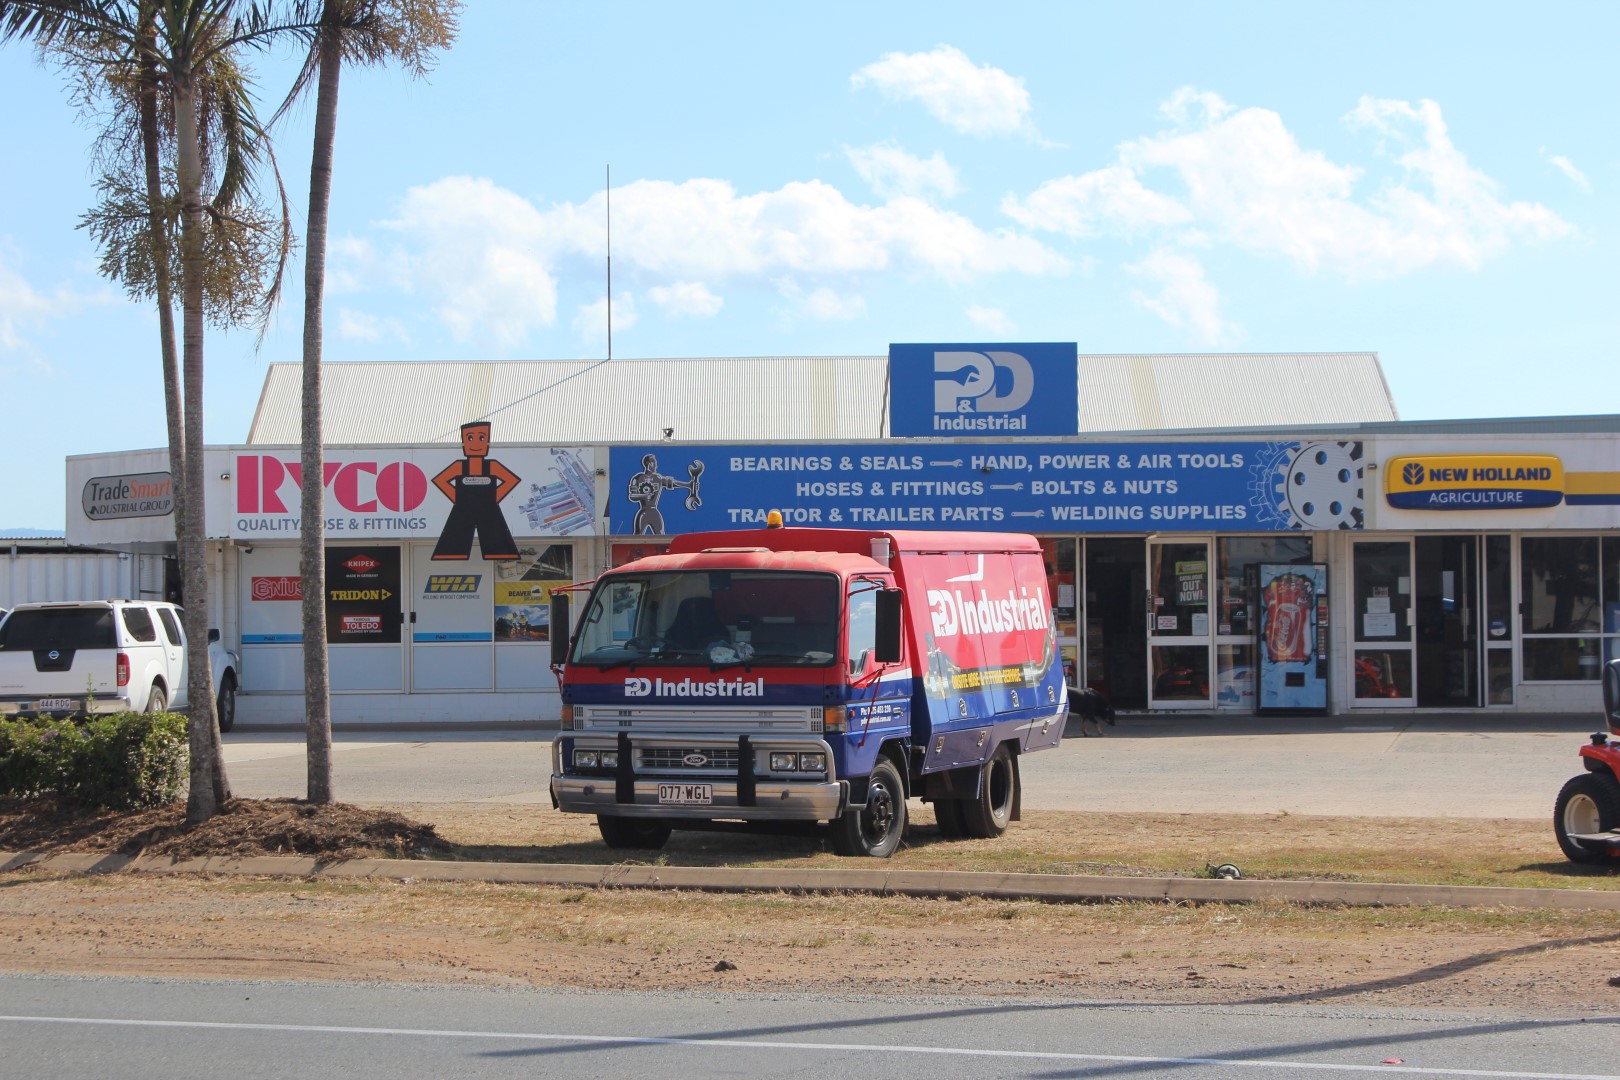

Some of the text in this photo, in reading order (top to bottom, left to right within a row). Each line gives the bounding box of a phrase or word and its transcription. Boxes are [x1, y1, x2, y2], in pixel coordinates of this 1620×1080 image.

[934, 414, 1026, 430] Industrial
[730, 454, 1244, 472] BEARINGS & SEALS HAND, POWER & AIR TOOLS
[1429, 467, 1551, 481] NEW HOLLAND
[91, 480, 171, 501] TradeSmart
[796, 480, 1178, 496] HOSES & FITTINGS BOLTS & NUTS
[1429, 492, 1522, 503] AGRICULTURE
[140, 500, 170, 511] GROUP
[728, 505, 1246, 522] TRATOR & TRAILER PARTS WELDING SUPPLIES
[237, 518, 301, 532] QUALITY
[349, 518, 359, 530] &
[364, 518, 427, 530] FITTINGS
[431, 576, 475, 591] WIA
[1182, 580, 1200, 591] OUT
[331, 590, 379, 600] TRIDON
[1180, 590, 1203, 601] NOW!
[955, 587, 1048, 634] Industrial
[656, 677, 764, 697] Industrial
